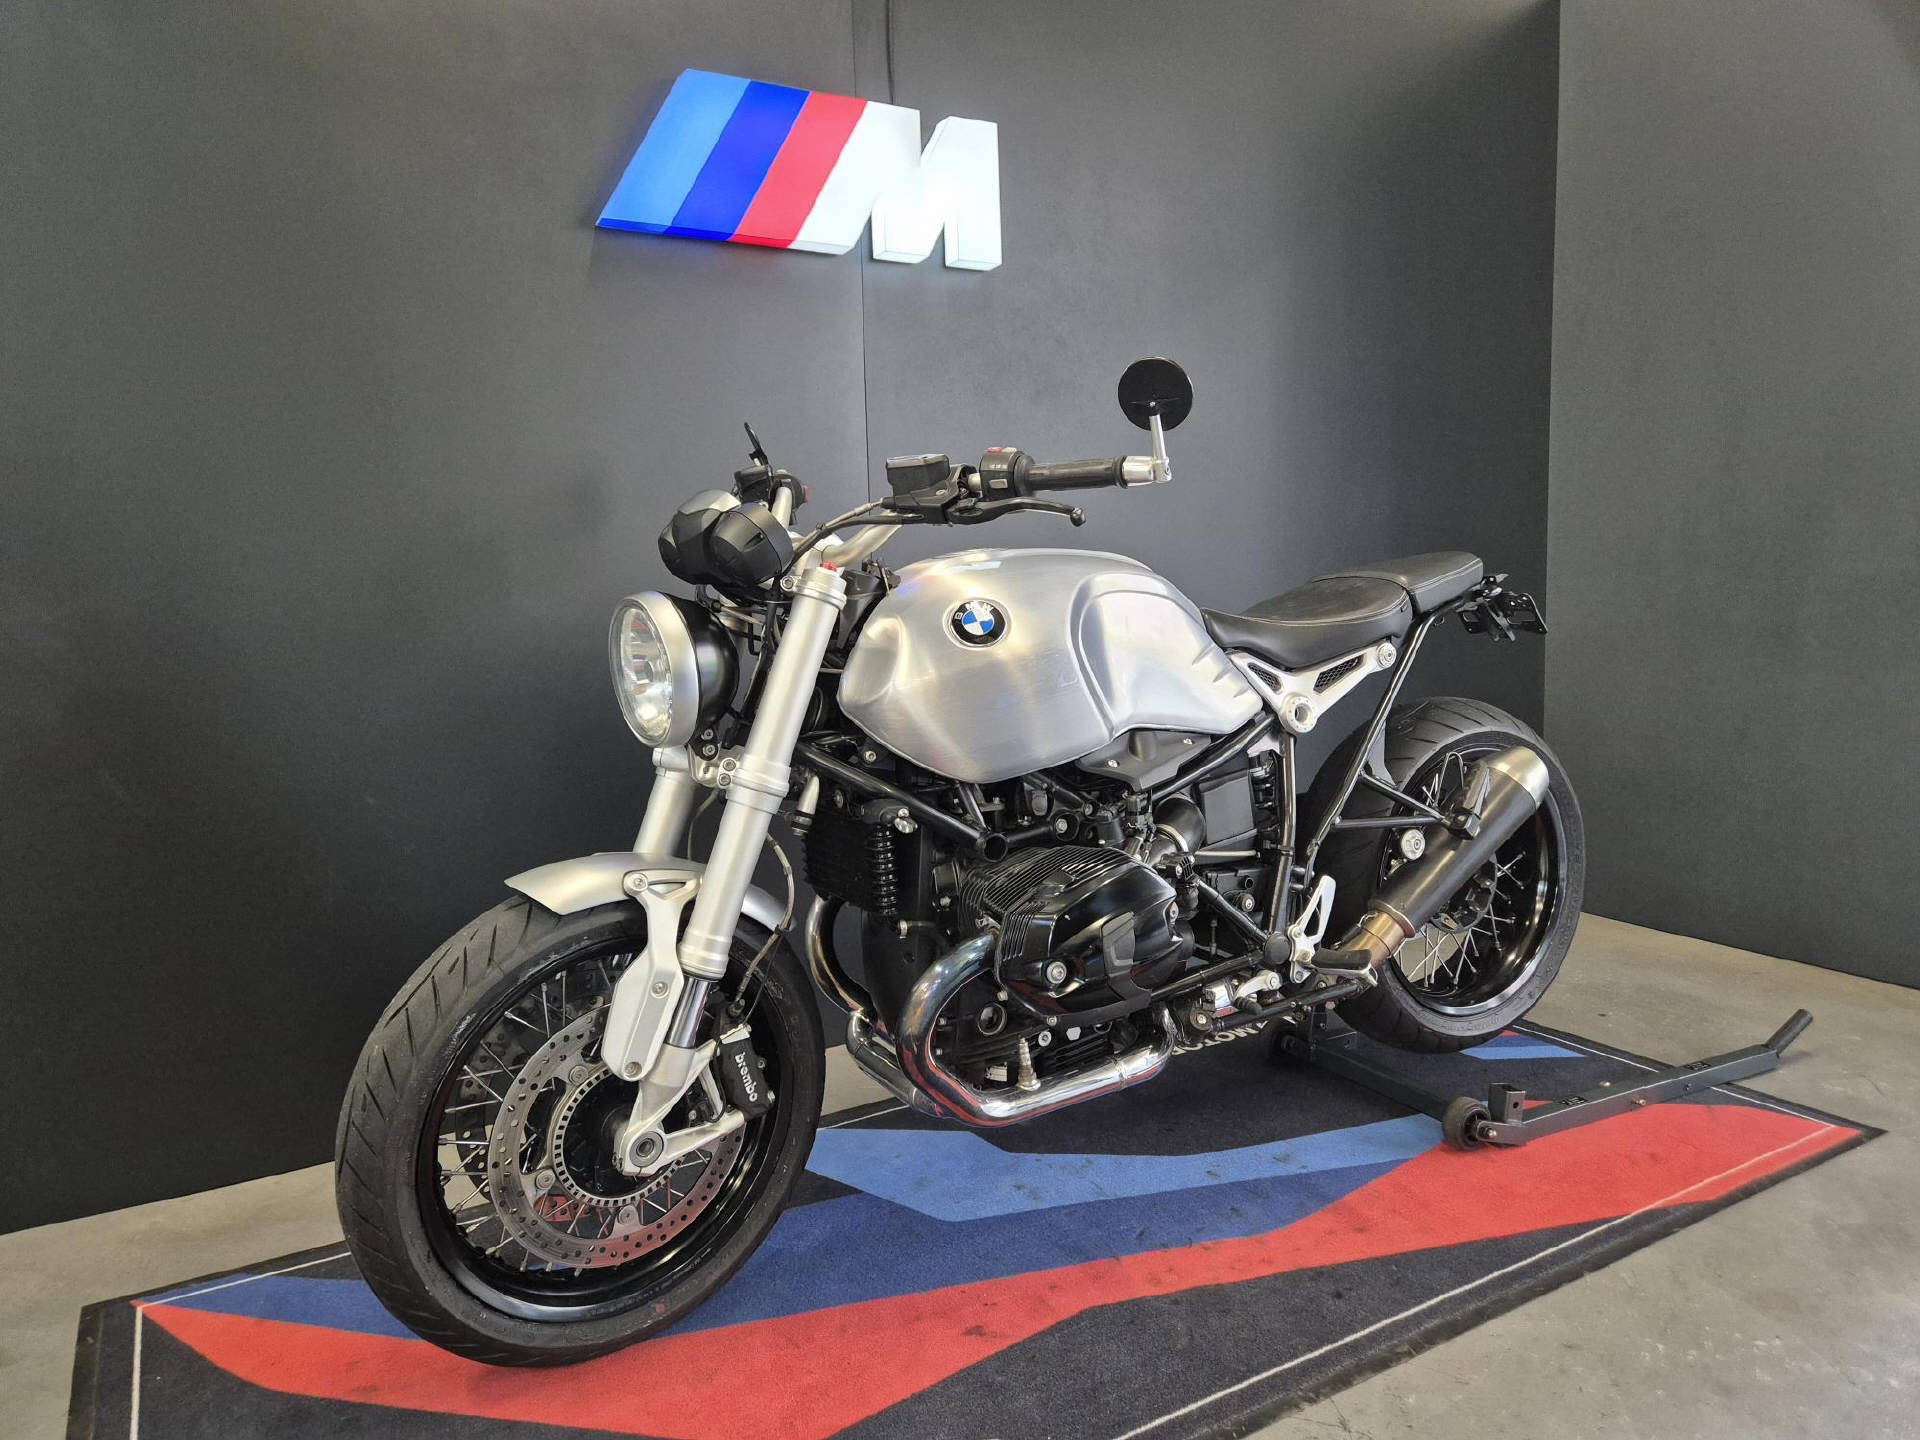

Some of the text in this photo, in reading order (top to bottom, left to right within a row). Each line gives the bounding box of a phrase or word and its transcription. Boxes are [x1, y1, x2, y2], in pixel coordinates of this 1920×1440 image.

[786, 100, 1002, 271] M
[954, 600, 994, 620] BMW
[735, 1052, 758, 1102] brembo
